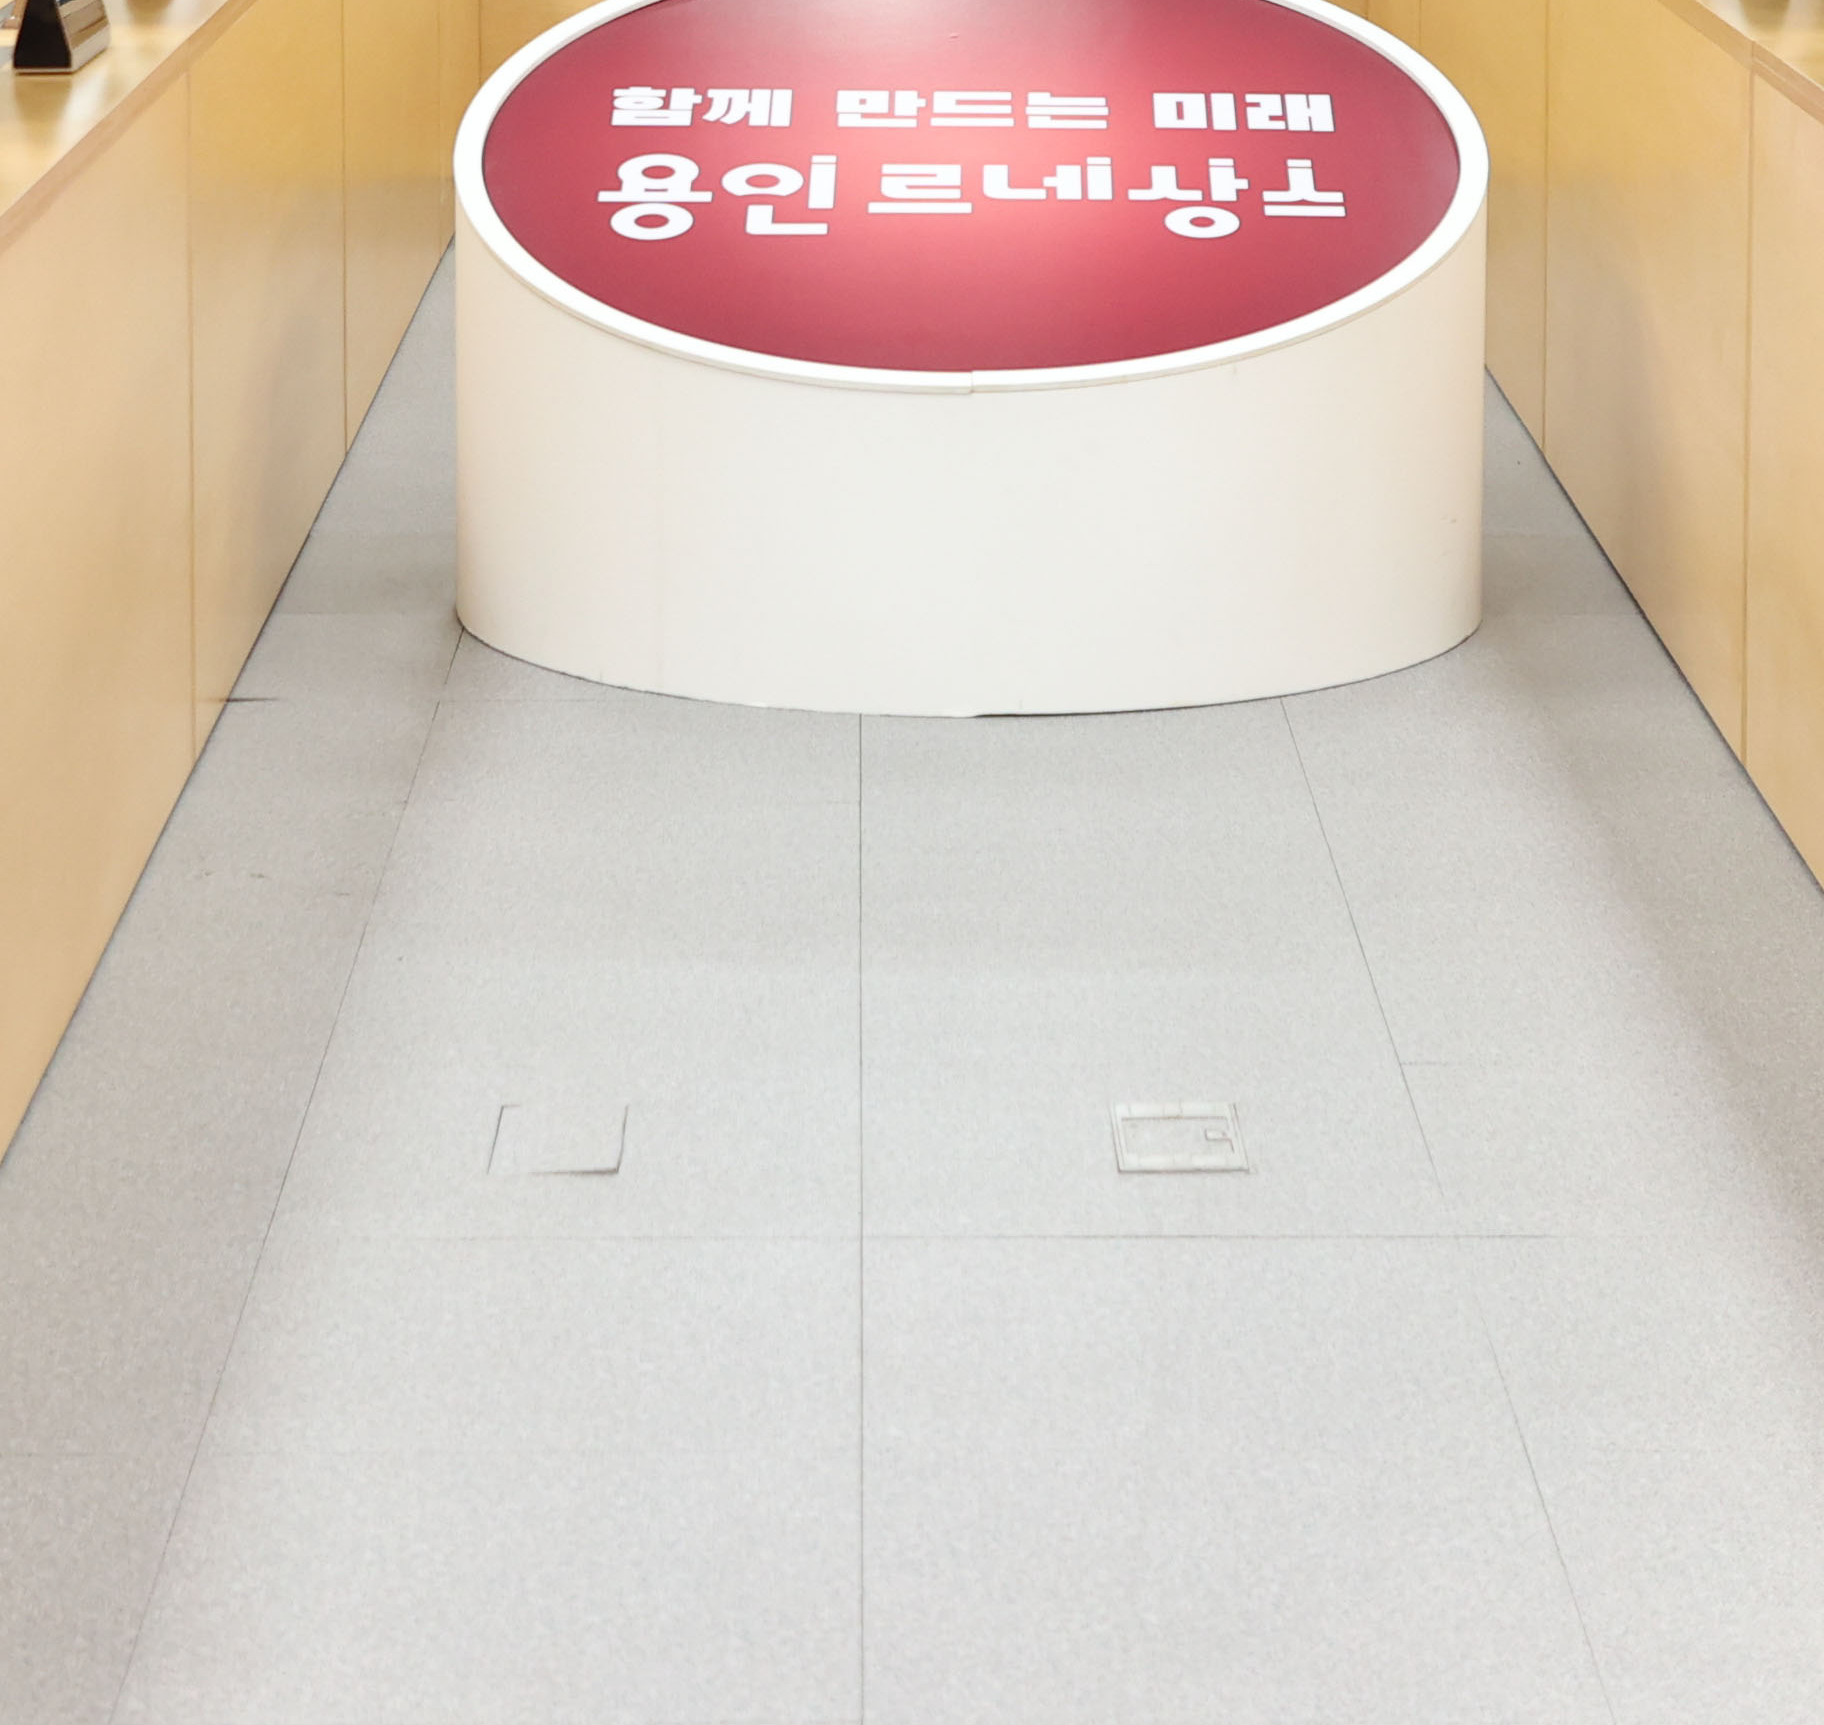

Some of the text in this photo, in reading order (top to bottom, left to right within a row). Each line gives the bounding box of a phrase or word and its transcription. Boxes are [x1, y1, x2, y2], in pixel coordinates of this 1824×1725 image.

[612, 88, 1337, 133] 함께 만드는 미래
[597, 154, 1348, 241] 용인 르네상스
